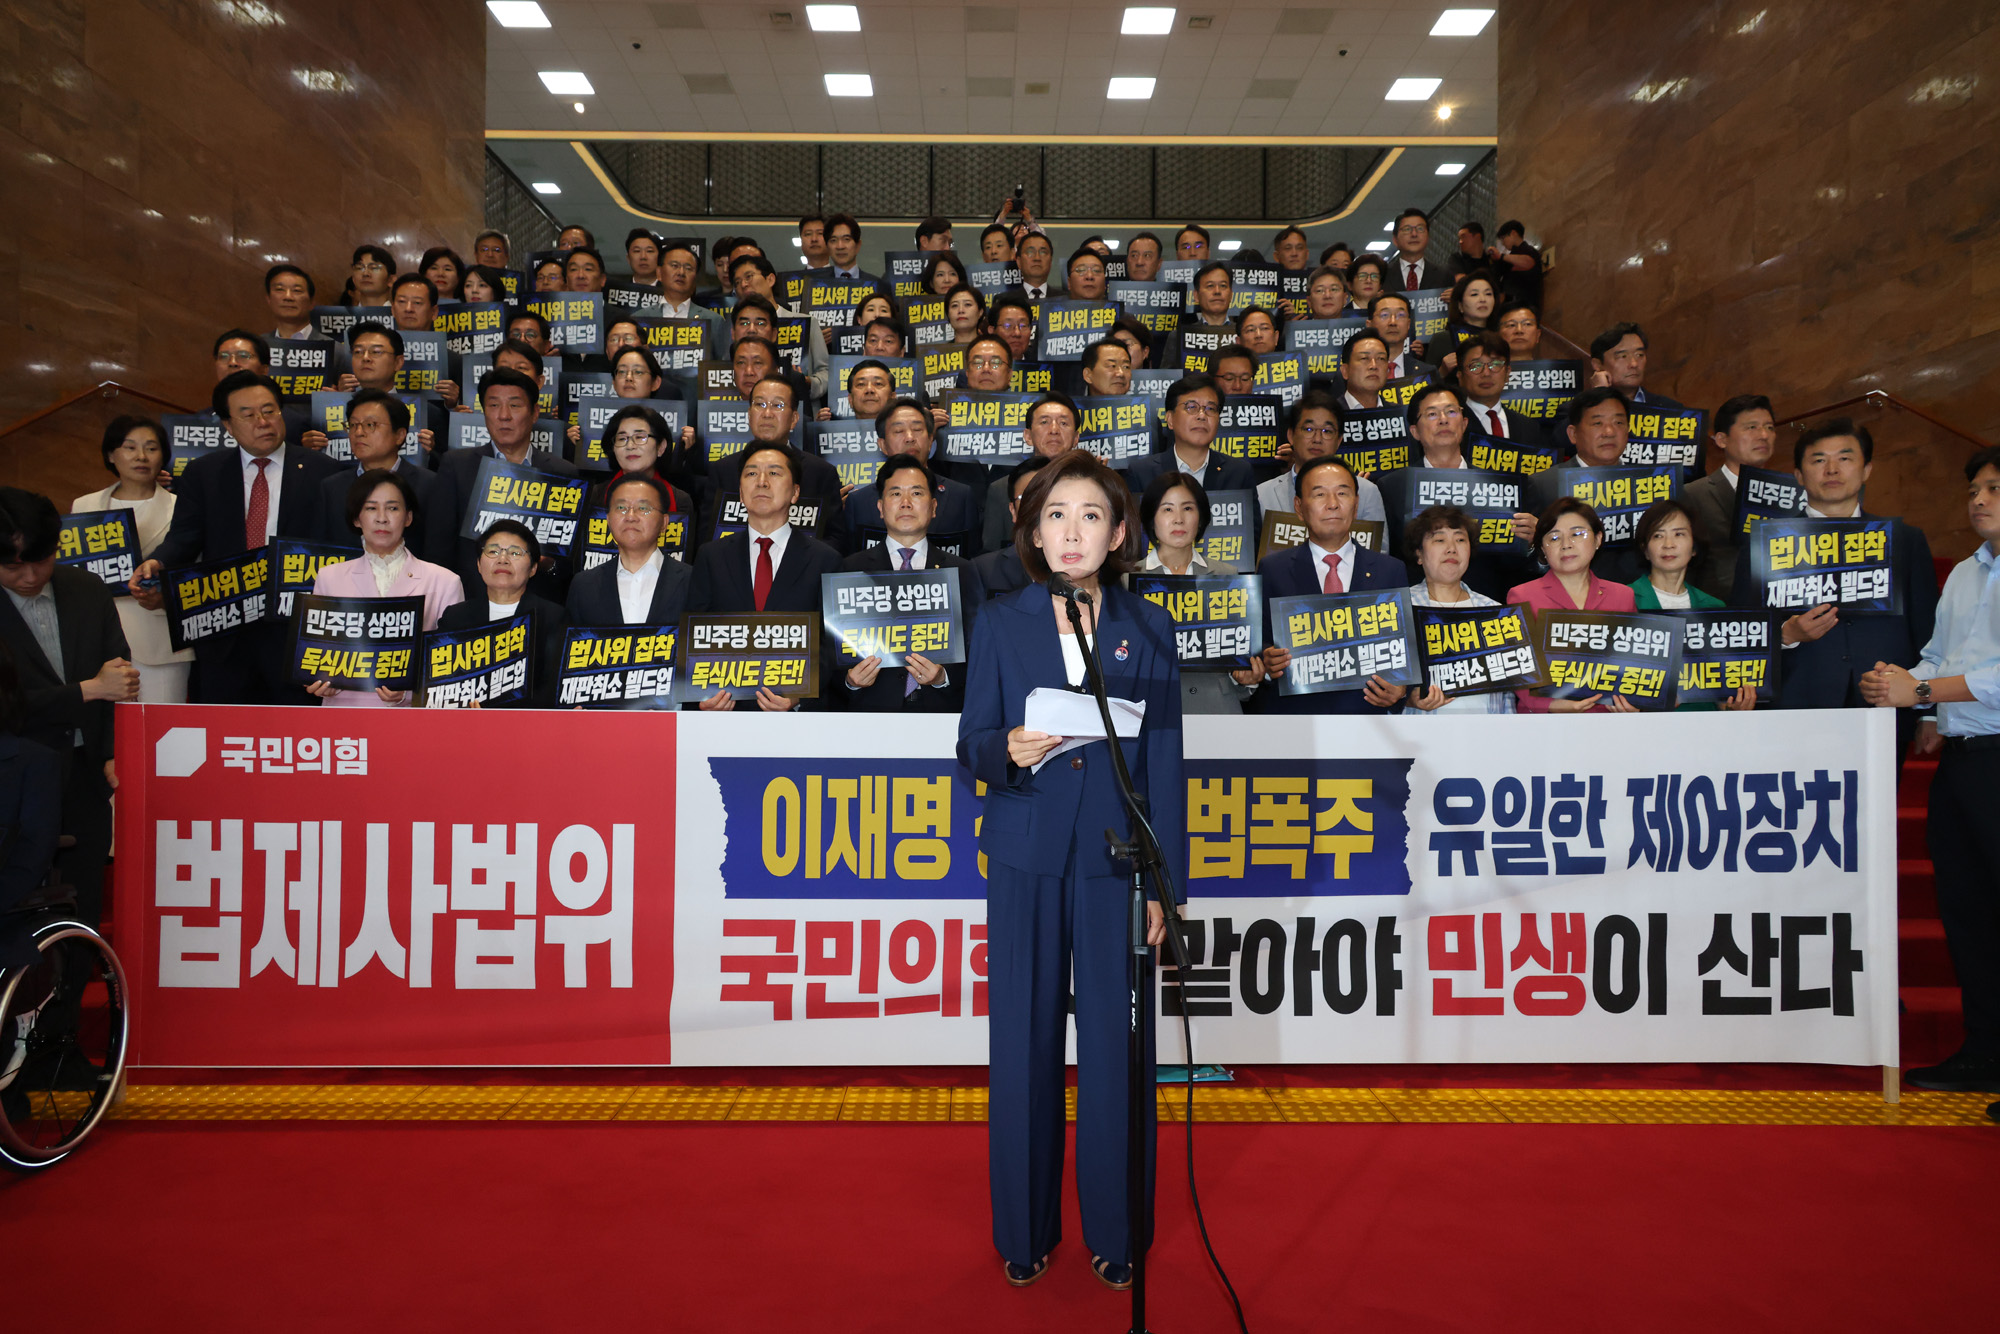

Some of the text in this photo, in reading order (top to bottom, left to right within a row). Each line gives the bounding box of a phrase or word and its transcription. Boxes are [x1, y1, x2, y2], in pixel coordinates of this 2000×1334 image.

[893, 259, 921, 275] 민주당
[972, 270, 1023, 287] 민주당 상임
[1248, 270, 1277, 286] 상임위
[812, 287, 848, 305] 법사위
[1284, 278, 1299, 292] 주당
[608, 289, 639, 306] 민주당
[1117, 290, 1180, 308] 민주당 상임위
[1254, 292, 1277, 309] 중단!
[475, 310, 500, 329] 집착
[569, 301, 594, 320] 집착
[909, 302, 945, 323] 법사위
[1049, 309, 1088, 331] 법사위
[1091, 308, 1116, 329] 집착
[566, 324, 596, 345] 빌드업
[778, 325, 802, 344] 집착
[916, 326, 943, 344] 판취소
[1155, 315, 1177, 331] 중단!
[643, 326, 702, 345] 사위 집착
[841, 336, 864, 351] 민주
[1046, 334, 1084, 356] 재판취소
[1185, 333, 1218, 350] 민주당
[1295, 329, 1329, 348] 민주당
[287, 349, 326, 368] 상임위
[673, 349, 703, 369] 빌드업
[925, 351, 963, 374] 법사위
[1271, 360, 1299, 381] 집착
[1308, 355, 1338, 374] 식시도
[294, 375, 324, 395] 중단!
[409, 370, 438, 390] 중단!
[708, 370, 736, 387] 민주
[1027, 370, 1051, 391] 집착
[1538, 370, 1575, 389] 상임위
[709, 412, 749, 432] 민주당
[951, 402, 999, 426] 법사위
[1077, 404, 1146, 433] 사위 집착
[1236, 405, 1275, 426] 상임위
[174, 426, 220, 447] 민주당
[462, 426, 492, 447] 민주
[1366, 416, 1406, 440] 상임위
[1629, 415, 1697, 439] 사위 집착
[819, 431, 861, 454] 민주당
[946, 431, 1033, 455] 재판취소 빌드
[1115, 433, 1149, 459] 빌드업
[1248, 436, 1277, 457] 중단!
[1380, 446, 1408, 468] 중단!
[1472, 445, 1553, 475] 법사위 집착
[1657, 445, 1697, 466] 빌드업
[837, 463, 872, 484] 식시도
[487, 475, 581, 513] 법사위 집착
[1419, 481, 1519, 508] 민주당 상임위
[1635, 475, 1671, 500] 집착
[1749, 479, 1796, 509] 민주당
[789, 506, 818, 527] 임위
[1210, 503, 1242, 527] 임위
[85, 521, 125, 553] 집착
[536, 518, 577, 546] 빌드업
[1274, 523, 1309, 545] 민주
[1602, 515, 1630, 541] 취소
[1208, 536, 1242, 560] 중단!
[1770, 530, 1886, 570] 법사위 집착
[178, 567, 239, 610] 법사위
[837, 583, 948, 614] 민주당 상임위
[1767, 568, 1889, 608] 재판취소 빌드업
[1209, 589, 1248, 620] 집착
[182, 610, 241, 641] 재판취소
[307, 609, 415, 638] 민주당 상임위
[1289, 601, 1398, 648] 법사위 집착
[1425, 614, 1524, 656] 법사위 집착
[1709, 621, 1767, 649] 상임위
[693, 625, 806, 649] 민주당 상임위
[841, 622, 950, 658] 독식시도 중단!
[1205, 625, 1250, 658] 빌드업
[1551, 623, 1609, 650] 민주당
[1612, 625, 1670, 657] 상임위
[300, 648, 411, 679] 독식시도 중단!
[431, 625, 525, 678] 법사위 집착
[568, 634, 675, 669] 법사위 집착
[1292, 638, 1406, 685] 재판취소 빌드업
[692, 659, 805, 689] 독식시도 중단!
[1485, 646, 1536, 682] 빌드업
[1725, 660, 1767, 689] 중단!
[489, 658, 526, 698] 빌드업
[560, 666, 674, 704] 재판취소 빌드업
[1549, 660, 1665, 698] 독식시도 중단!
[220, 736, 368, 776] 국민의힘
[761, 774, 952, 880] 이재명
[1186, 776, 1374, 880] 법폭주
[1428, 773, 1607, 877] 유일한
[1627, 770, 1859, 873] 제어장치
[155, 818, 635, 989] 법제사법위
[719, 918, 988, 1021] 국민의
[1160, 915, 1403, 1017] 맡아야
[1427, 912, 1668, 1017] 민생이
[1698, 912, 1863, 1017] 산다
